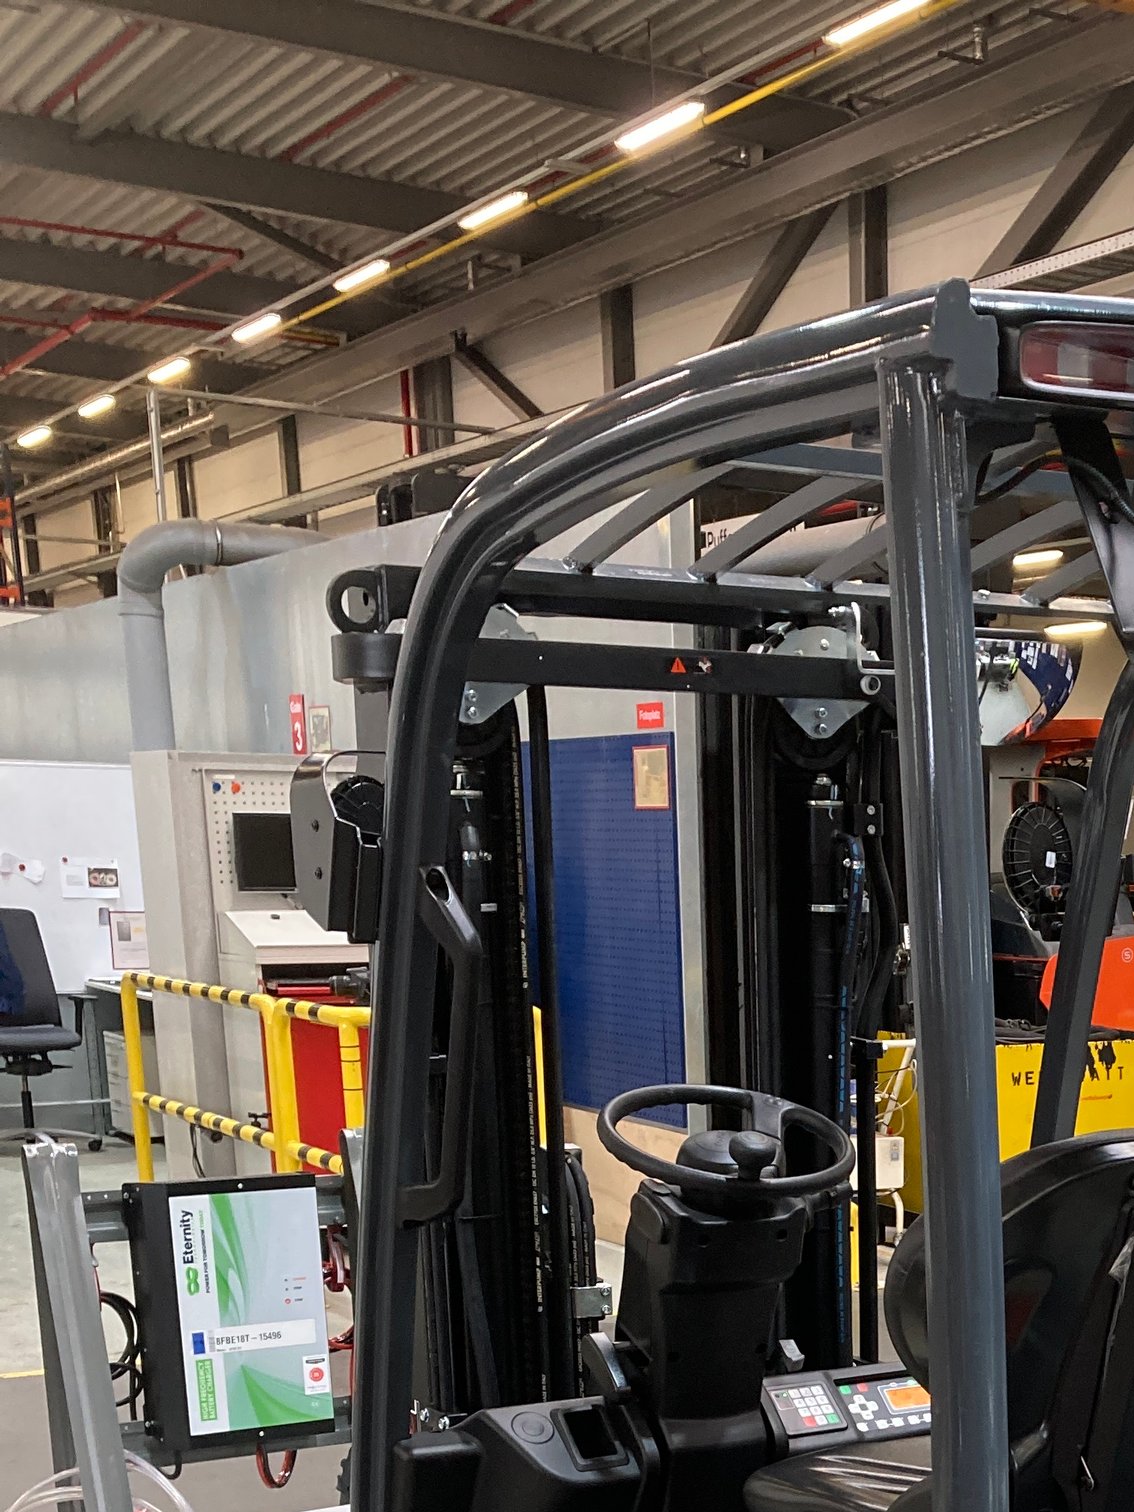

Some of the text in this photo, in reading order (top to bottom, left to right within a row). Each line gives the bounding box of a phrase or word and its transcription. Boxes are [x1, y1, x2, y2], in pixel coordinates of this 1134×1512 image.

[294, 721, 303, 752] 3
[1011, 1066, 1124, 1086] WEATT
[180, 1210, 194, 1265] Eternity
[259, 1331, 282, 1341] 15496
